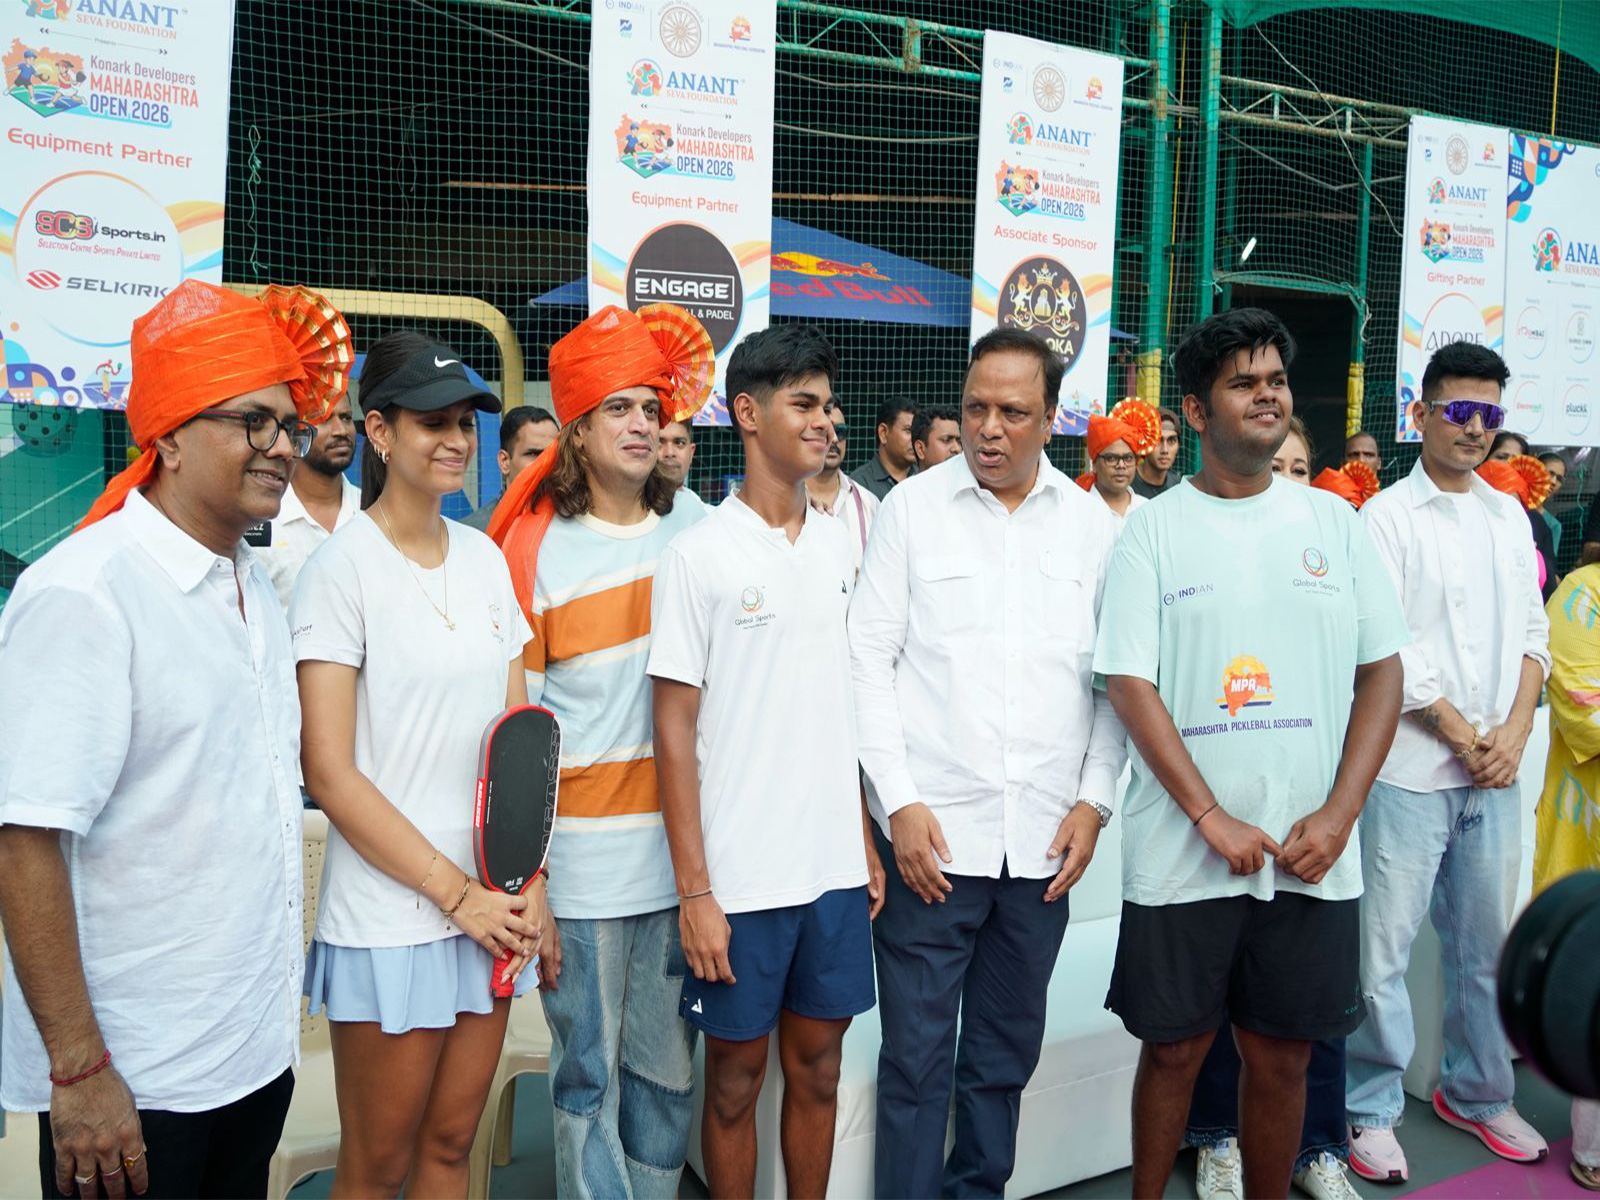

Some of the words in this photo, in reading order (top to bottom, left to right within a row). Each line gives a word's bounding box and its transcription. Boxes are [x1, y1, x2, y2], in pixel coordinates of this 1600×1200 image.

[76, 0, 178, 28] ANANT
[76, 14, 102, 27] SEVA
[105, 19, 177, 40] FOUNDATION
[90, 55, 131, 74] Konark
[134, 62, 196, 85] Developers
[90, 73, 199, 108] MAHARASHTRA
[666, 71, 739, 96] ANANT
[90, 93, 127, 117] OPEN
[132, 100, 169, 123] 2026
[676, 124, 706, 138] Konark
[708, 126, 752, 143] Developers
[1036, 123, 1092, 147] ANANT
[7, 127, 113, 157] Equipment
[121, 144, 193, 168] Partner
[677, 139, 755, 162] MAHARASHTRA
[677, 155, 704, 173] OPEN
[706, 159, 734, 177] 2026
[1042, 170, 1064, 182] Konark
[1065, 173, 1100, 190] Developers
[632, 191, 692, 209] Equipment
[697, 197, 739, 213] Partner
[1041, 184, 1101, 206] MAHARASHTRA
[1448, 185, 1489, 202] ANANT
[1041, 197, 1062, 214] OPEN
[1063, 203, 1085, 218] 2026
[36, 210, 94, 240] SCS
[994, 225, 1048, 244] Associate
[1052, 233, 1098, 251] Sponsor
[66, 277, 168, 298] SELKIRK
[635, 277, 729, 299] ENGAGE
[1427, 272, 1454, 286] Gifting
[1457, 274, 1486, 286] Partner
[770, 278, 836, 298] ed
[832, 281, 934, 307] Bull
[697, 308, 704, 319] &
[706, 309, 735, 320] PADEL
[1178, 584, 1214, 599] INDIAN
[1292, 578, 1317, 588] Global
[734, 617, 754, 626] Global
[1181, 722, 1229, 738] MAHARASHTRA
[1231, 719, 1272, 732] PICKLEBALL
[1273, 717, 1313, 729] ASSOCIATION
